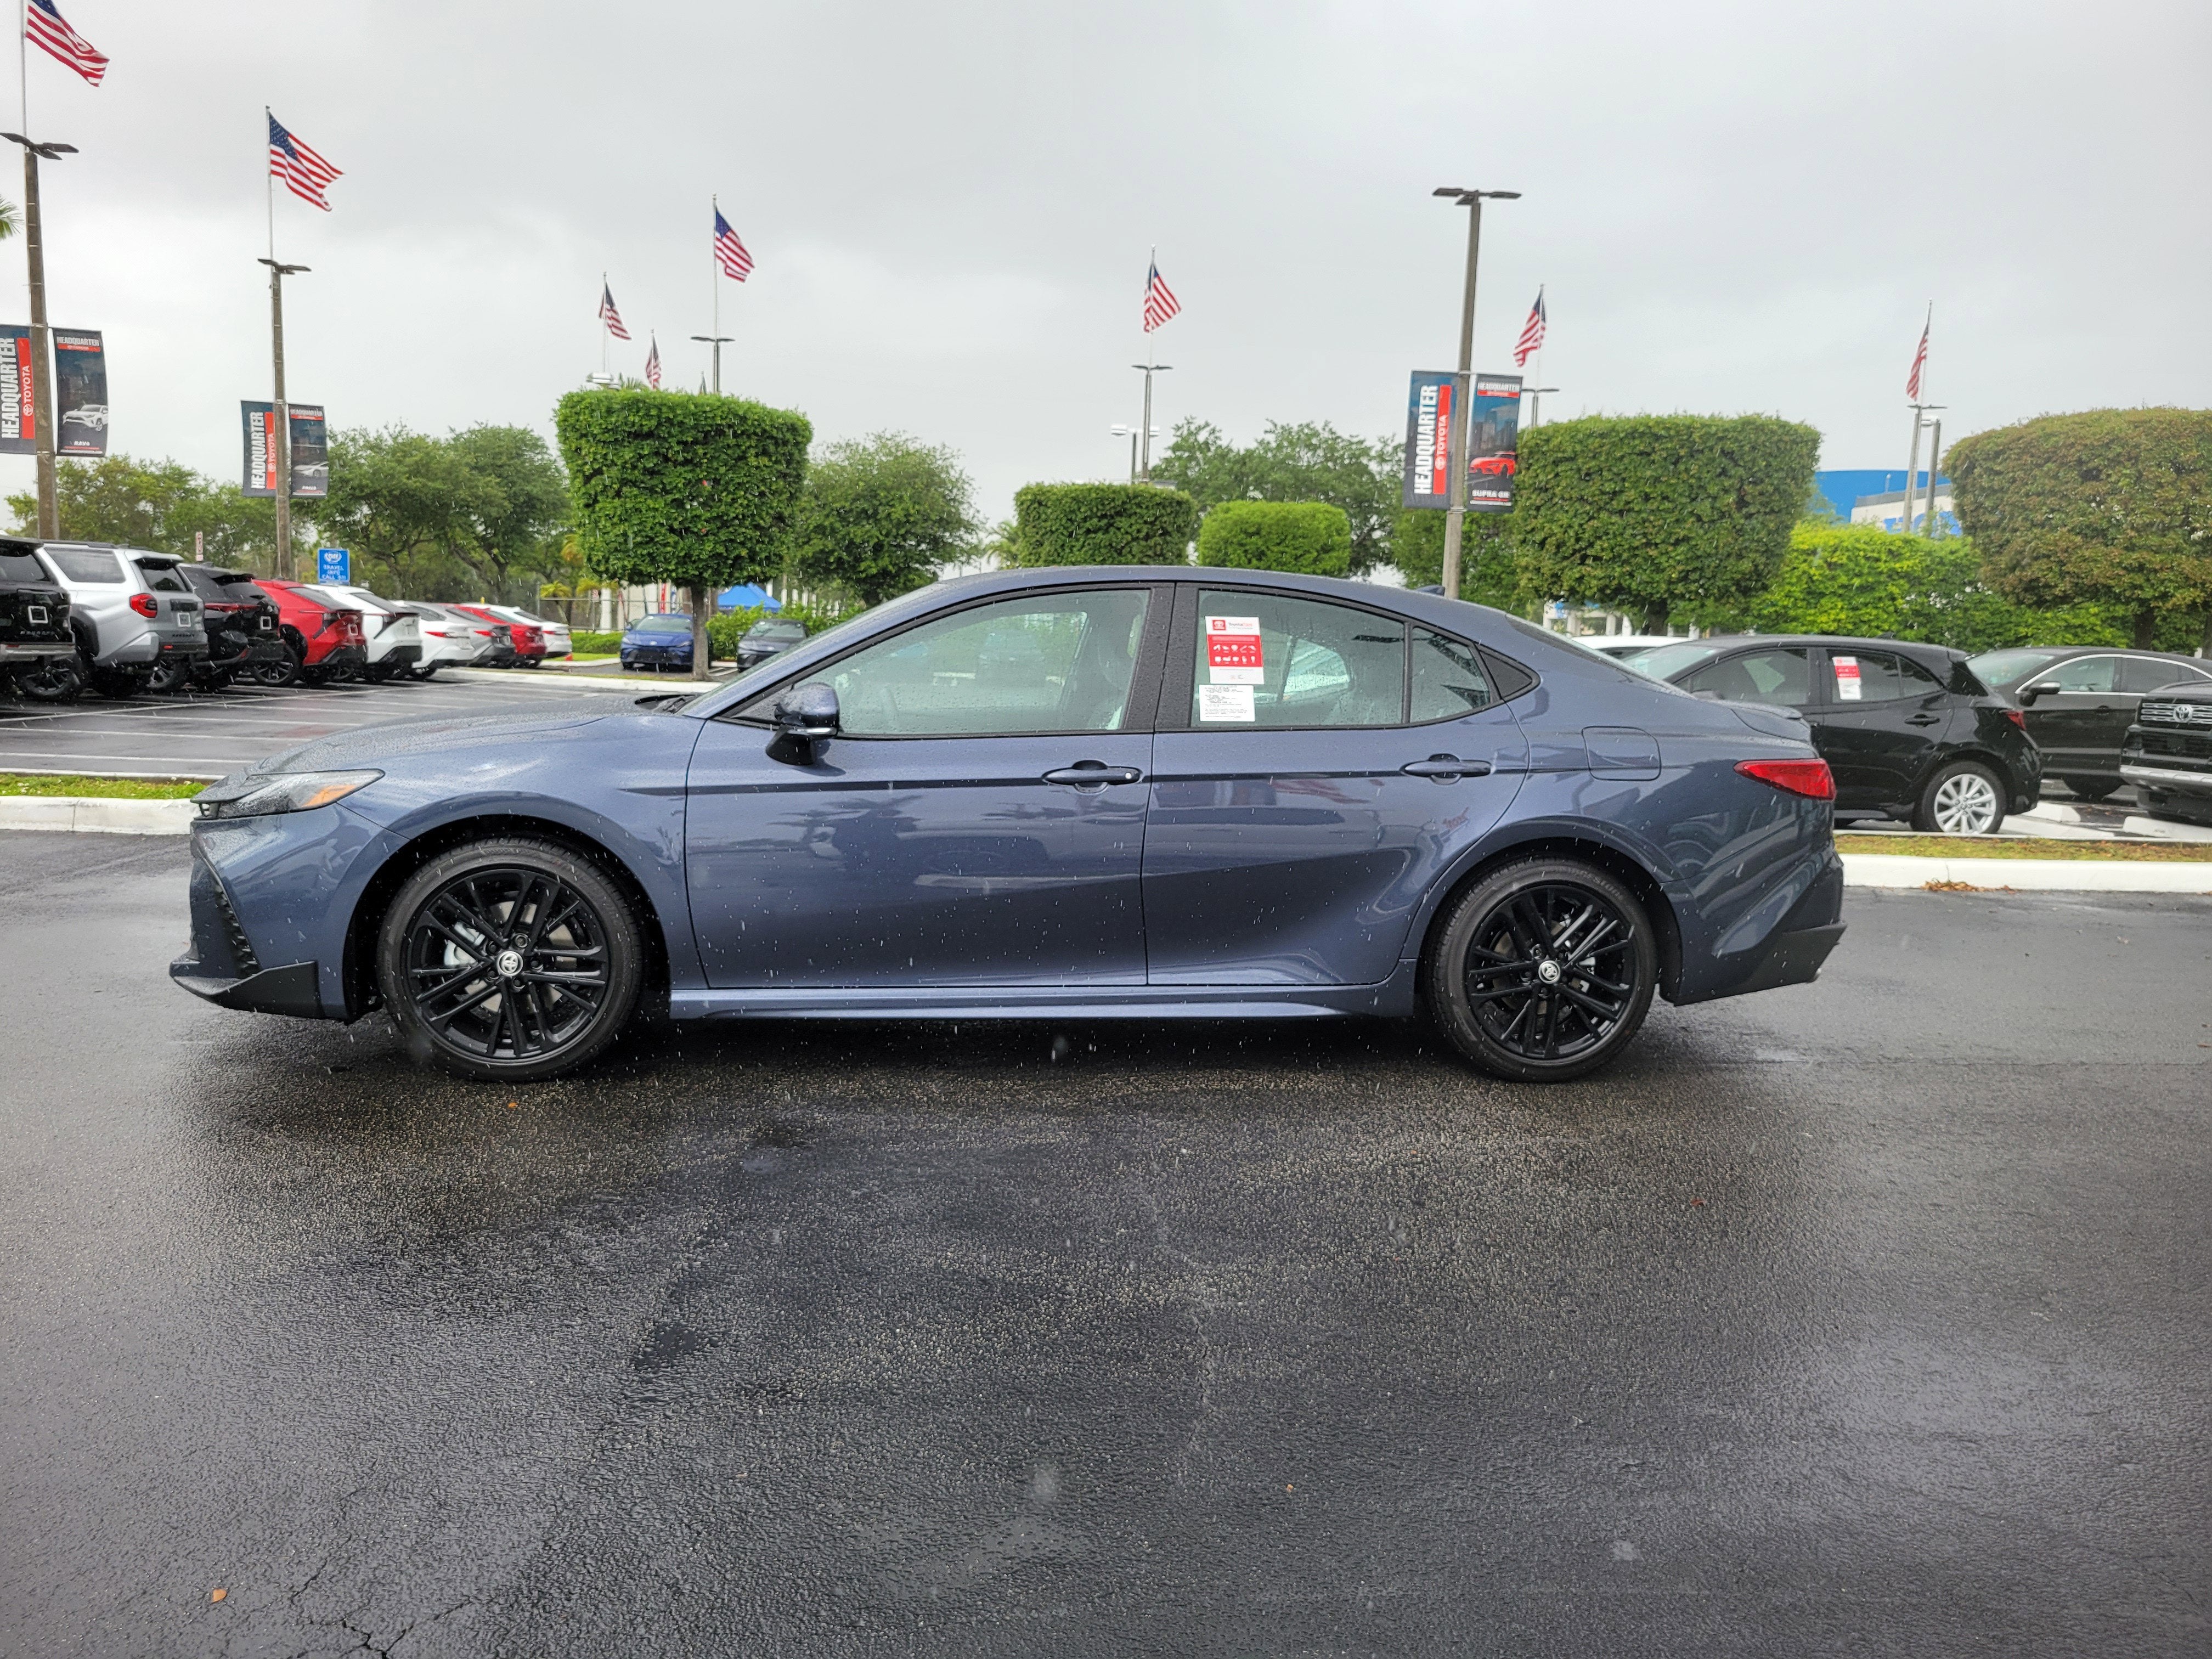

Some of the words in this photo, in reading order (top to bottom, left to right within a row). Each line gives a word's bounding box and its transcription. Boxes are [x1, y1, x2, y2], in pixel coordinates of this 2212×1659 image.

[0, 338, 21, 438] HEADQUARTER
[22, 365, 32, 403] TOYOTA
[250, 411, 267, 489] HEADQUARTER
[1414, 385, 1438, 494] HEADQUARTER
[1436, 414, 1448, 455] TOYOTA
